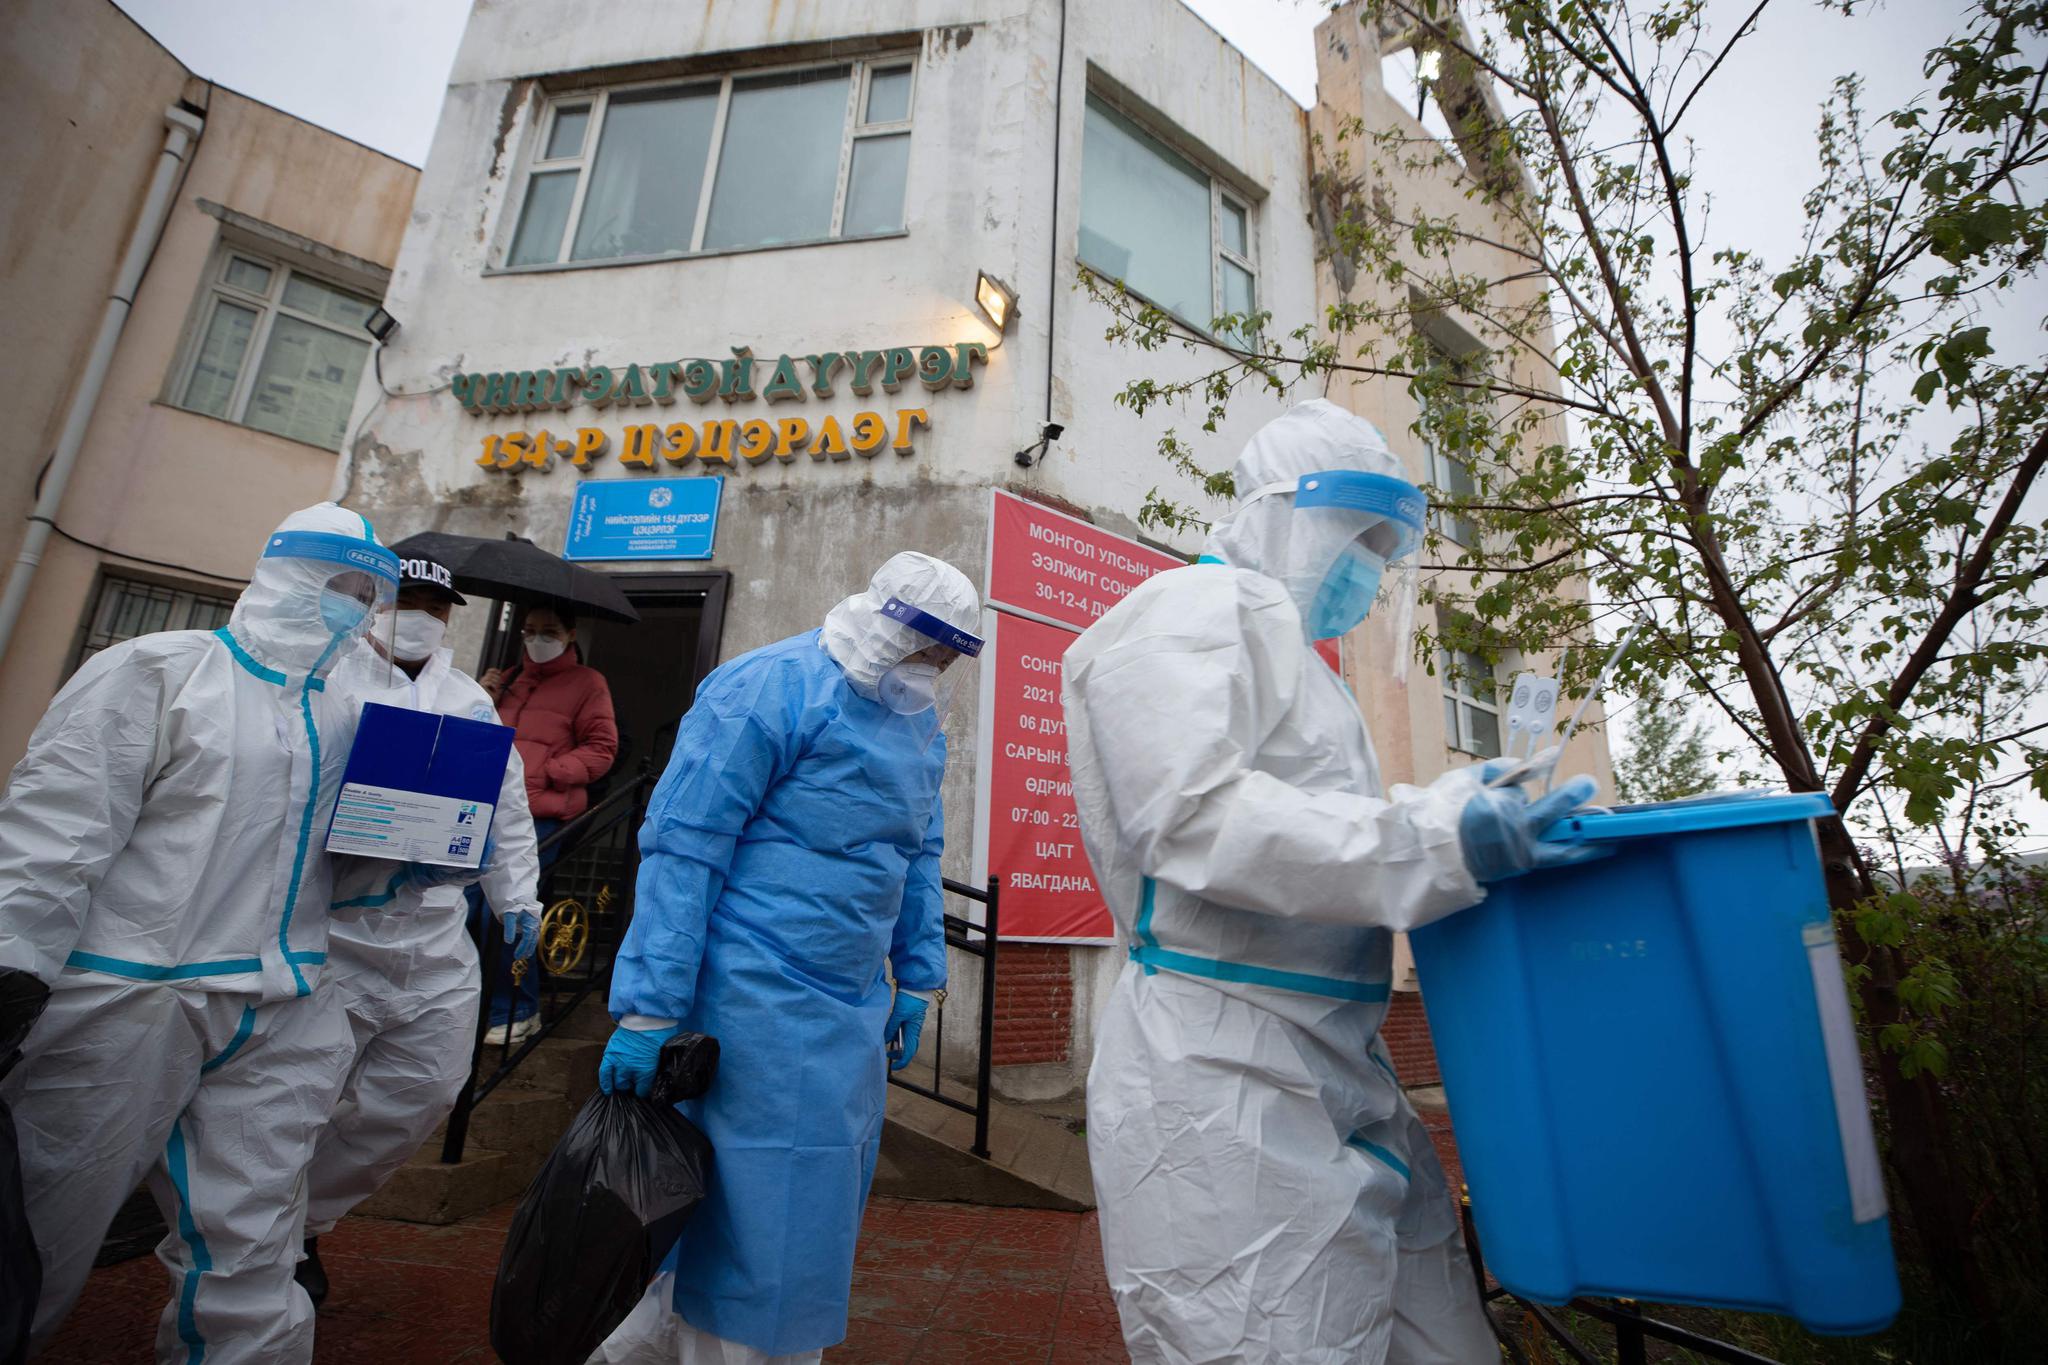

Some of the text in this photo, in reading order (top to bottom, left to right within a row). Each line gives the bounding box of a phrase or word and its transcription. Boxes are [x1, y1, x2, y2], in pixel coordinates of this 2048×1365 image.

[451, 342, 989, 412] ЧИНГЭЛТЭЙ ДҮҮРЭГ
[475, 407, 930, 471] 154-Р ЦЭЦЭРЛЭГ
[663, 513, 676, 523] 154
[350, 551, 376, 565] FACE
[1029, 522, 1149, 578] МОНГОЛ УЛСЫН
[399, 558, 452, 589] POLICE
[1031, 552, 1097, 587] ЭЭЛЖИТ
[1035, 582, 1088, 612] 30-12-4
[1021, 655, 1063, 677] СОНГ
[1023, 685, 1054, 704] 2021
[1020, 714, 1068, 736] 06 ДУГ
[1005, 743, 1061, 765] САРЫН
[1012, 807, 1049, 825] 07:00
[1036, 842, 1074, 860] ЦАГТ
[1010, 872, 1095, 893] ЯВАГДАНА.
